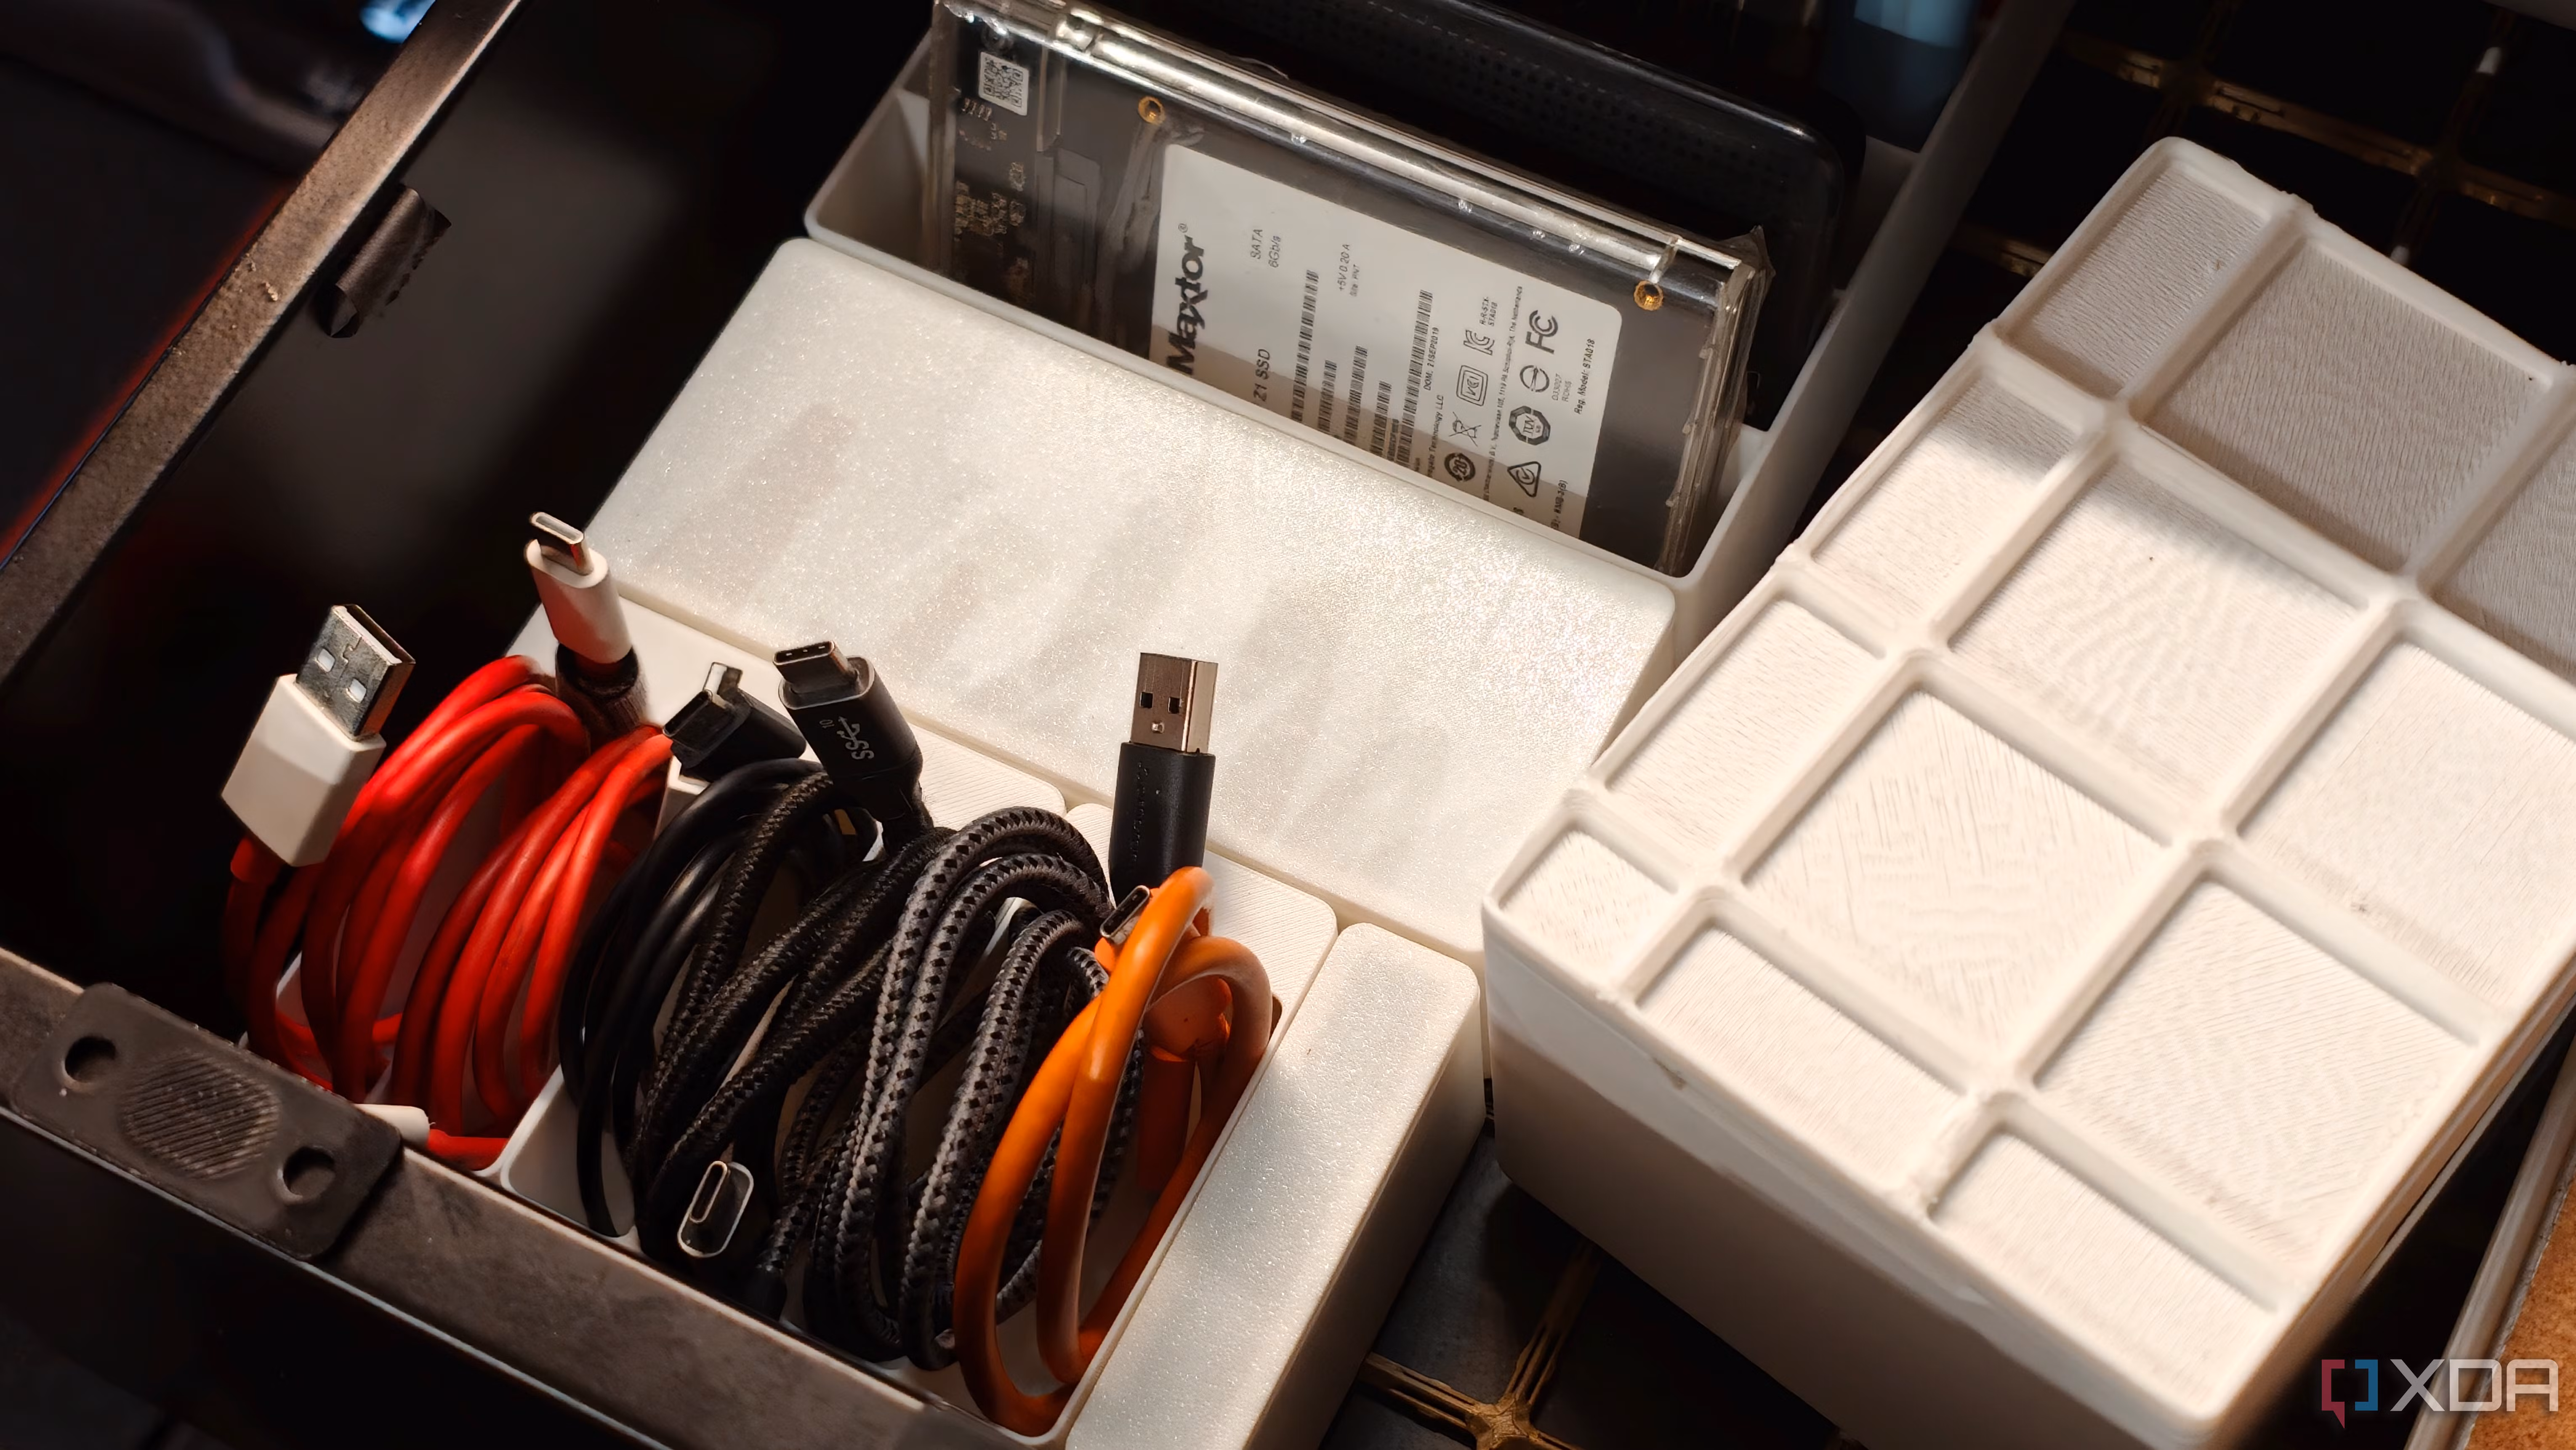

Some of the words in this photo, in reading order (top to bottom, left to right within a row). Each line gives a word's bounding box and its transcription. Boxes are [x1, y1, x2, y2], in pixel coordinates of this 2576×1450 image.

[1250, 229, 1263, 259] SATA
[1166, 235, 1208, 375] Maxtor
[1255, 349, 1270, 380] SSD
